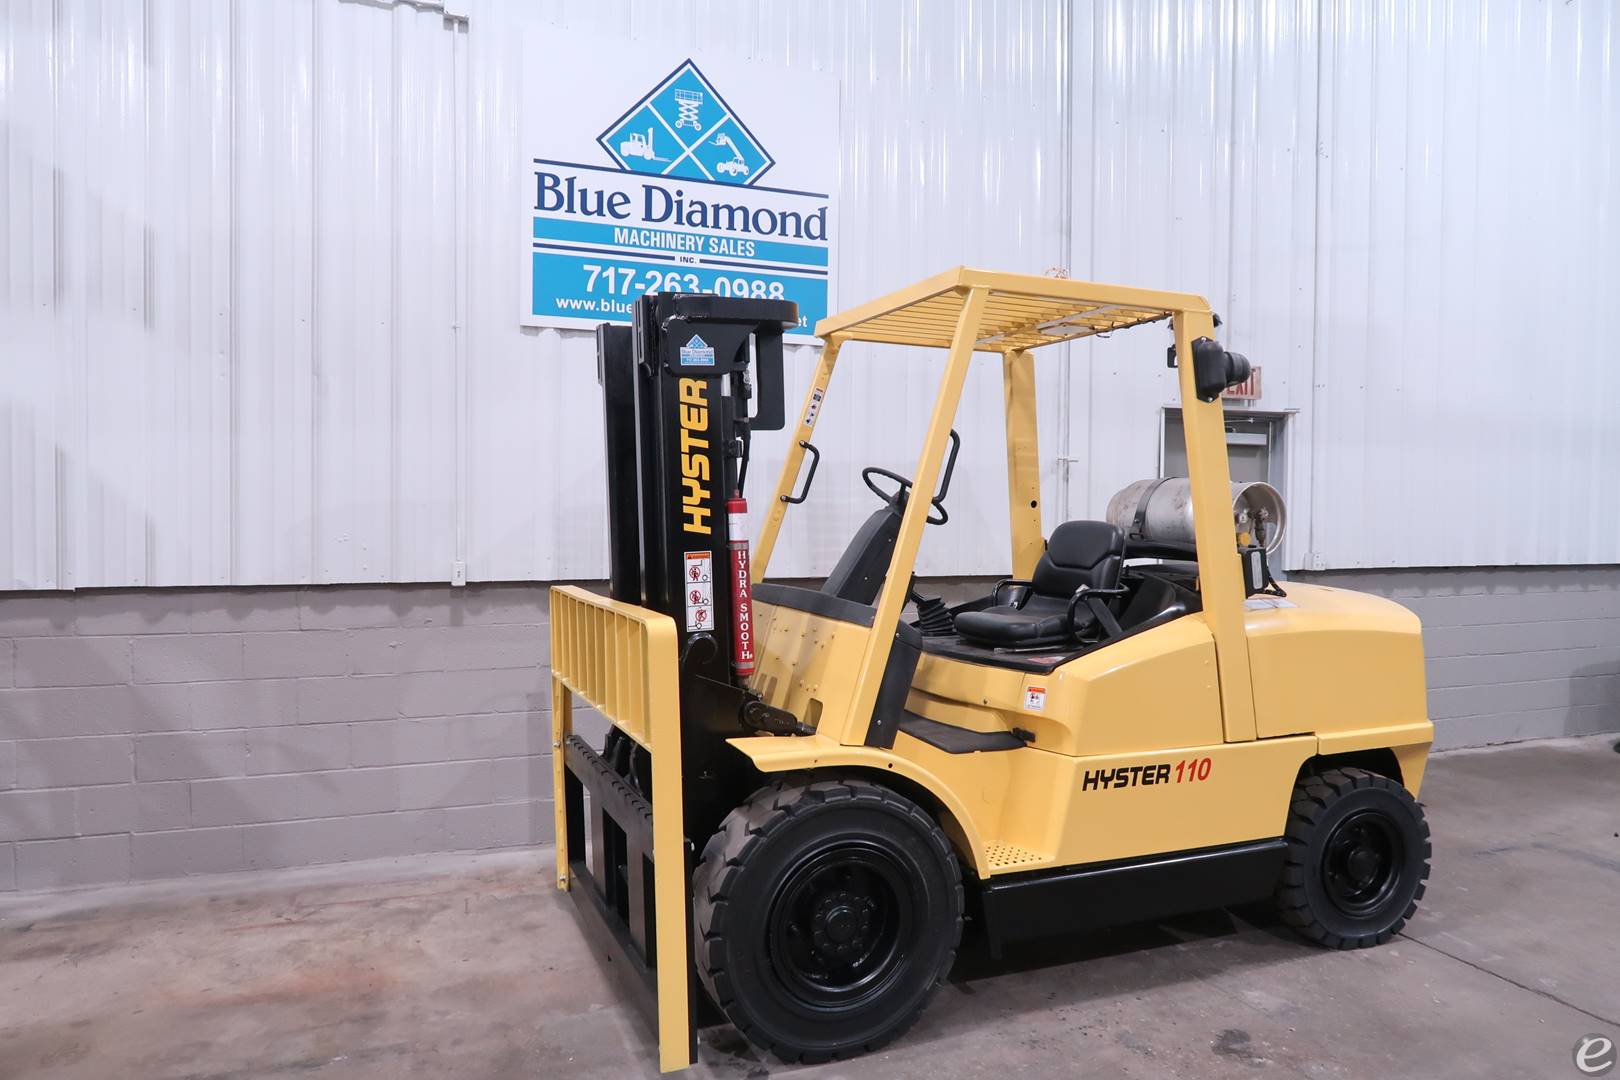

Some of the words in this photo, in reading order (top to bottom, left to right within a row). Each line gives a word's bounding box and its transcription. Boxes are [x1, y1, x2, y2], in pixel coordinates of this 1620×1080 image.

[534, 171, 631, 220] Blue
[641, 184, 828, 241] Diamond
[614, 227, 704, 252] MACHINERY
[709, 237, 756, 257] SALES
[679, 256, 697, 265] INC.
[583, 264, 785, 300] 717-263-0988
[679, 377, 712, 535] HYSTER
[737, 550, 748, 598] HYDRA
[739, 602, 750, 659] SMOOTH
[1082, 763, 1171, 792] HYSTER
[1175, 757, 1212, 784] 110
